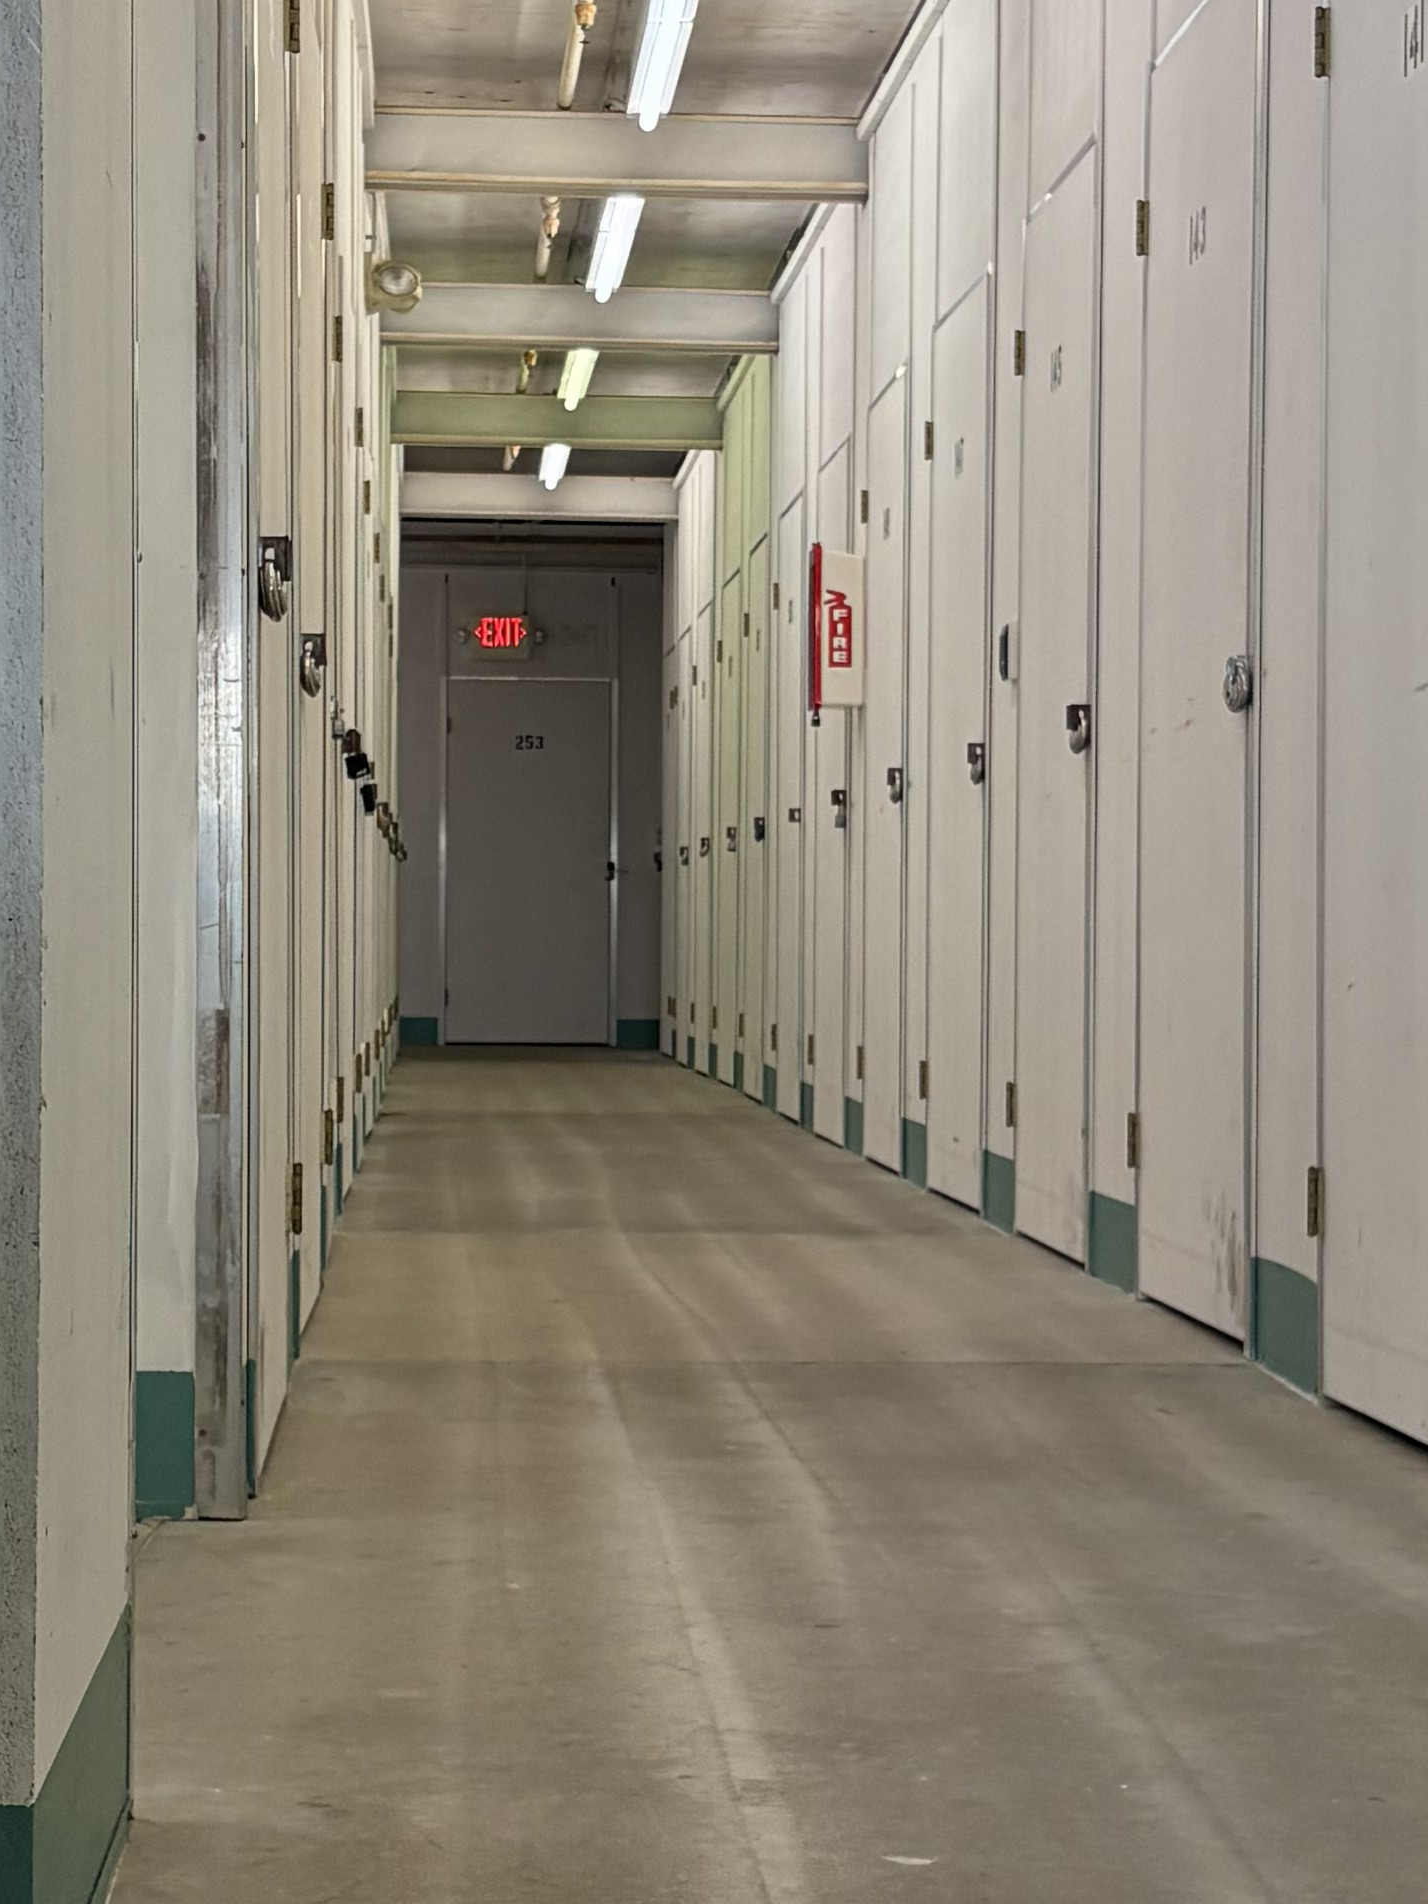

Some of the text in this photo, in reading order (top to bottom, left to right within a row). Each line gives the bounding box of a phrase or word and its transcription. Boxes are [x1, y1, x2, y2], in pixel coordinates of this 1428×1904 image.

[480, 617, 523, 647] EXIT
[832, 608, 849, 663] FIRE
[515, 735, 544, 750] 253
